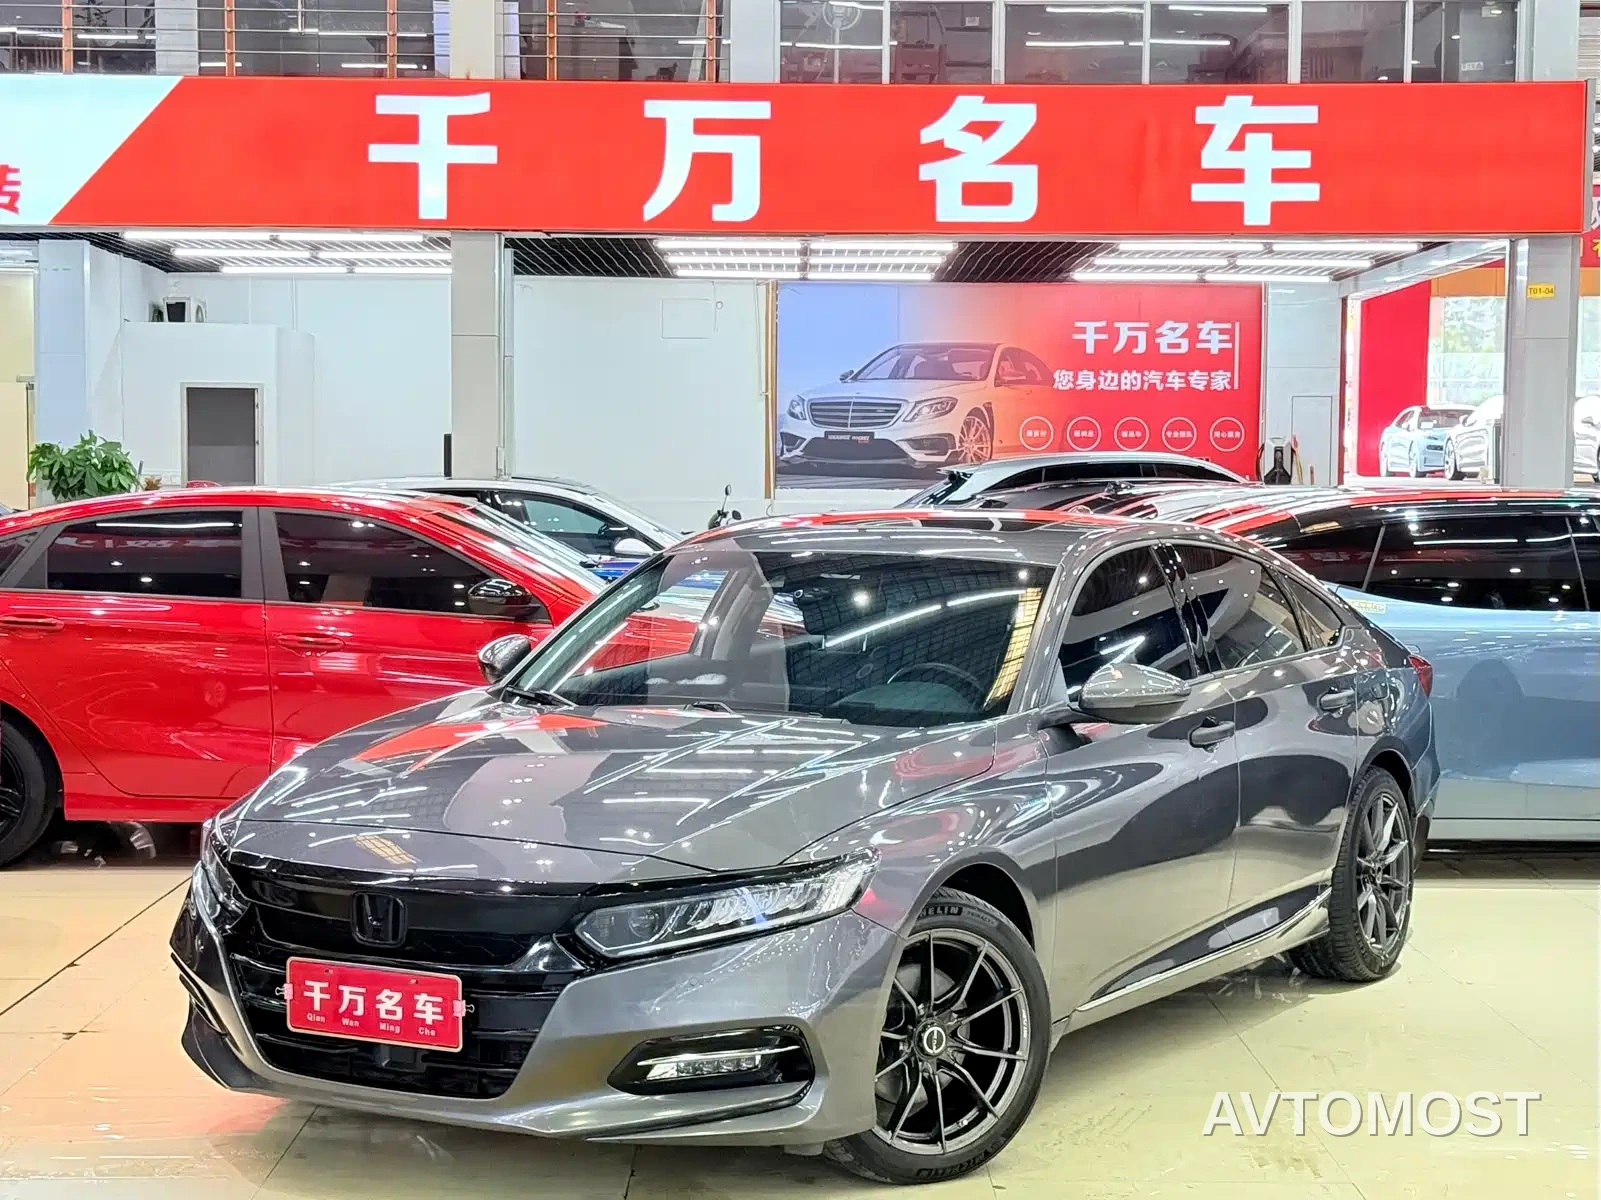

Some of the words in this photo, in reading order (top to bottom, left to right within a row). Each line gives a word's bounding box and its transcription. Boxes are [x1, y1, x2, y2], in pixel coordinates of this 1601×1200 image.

[368, 92, 1321, 225] 千万名车
[1528, 287, 1554, 295] T01-04
[1072, 320, 1233, 355] 千万名车
[1053, 369, 1232, 392] 您身边的汽车专家
[921, 906, 959, 917] HELIN
[303, 980, 444, 1025] 千万名车
[306, 1012, 326, 1023] Qian
[341, 1017, 360, 1028] Wan
[379, 1022, 401, 1034] Ming
[418, 1026, 436, 1037] Che
